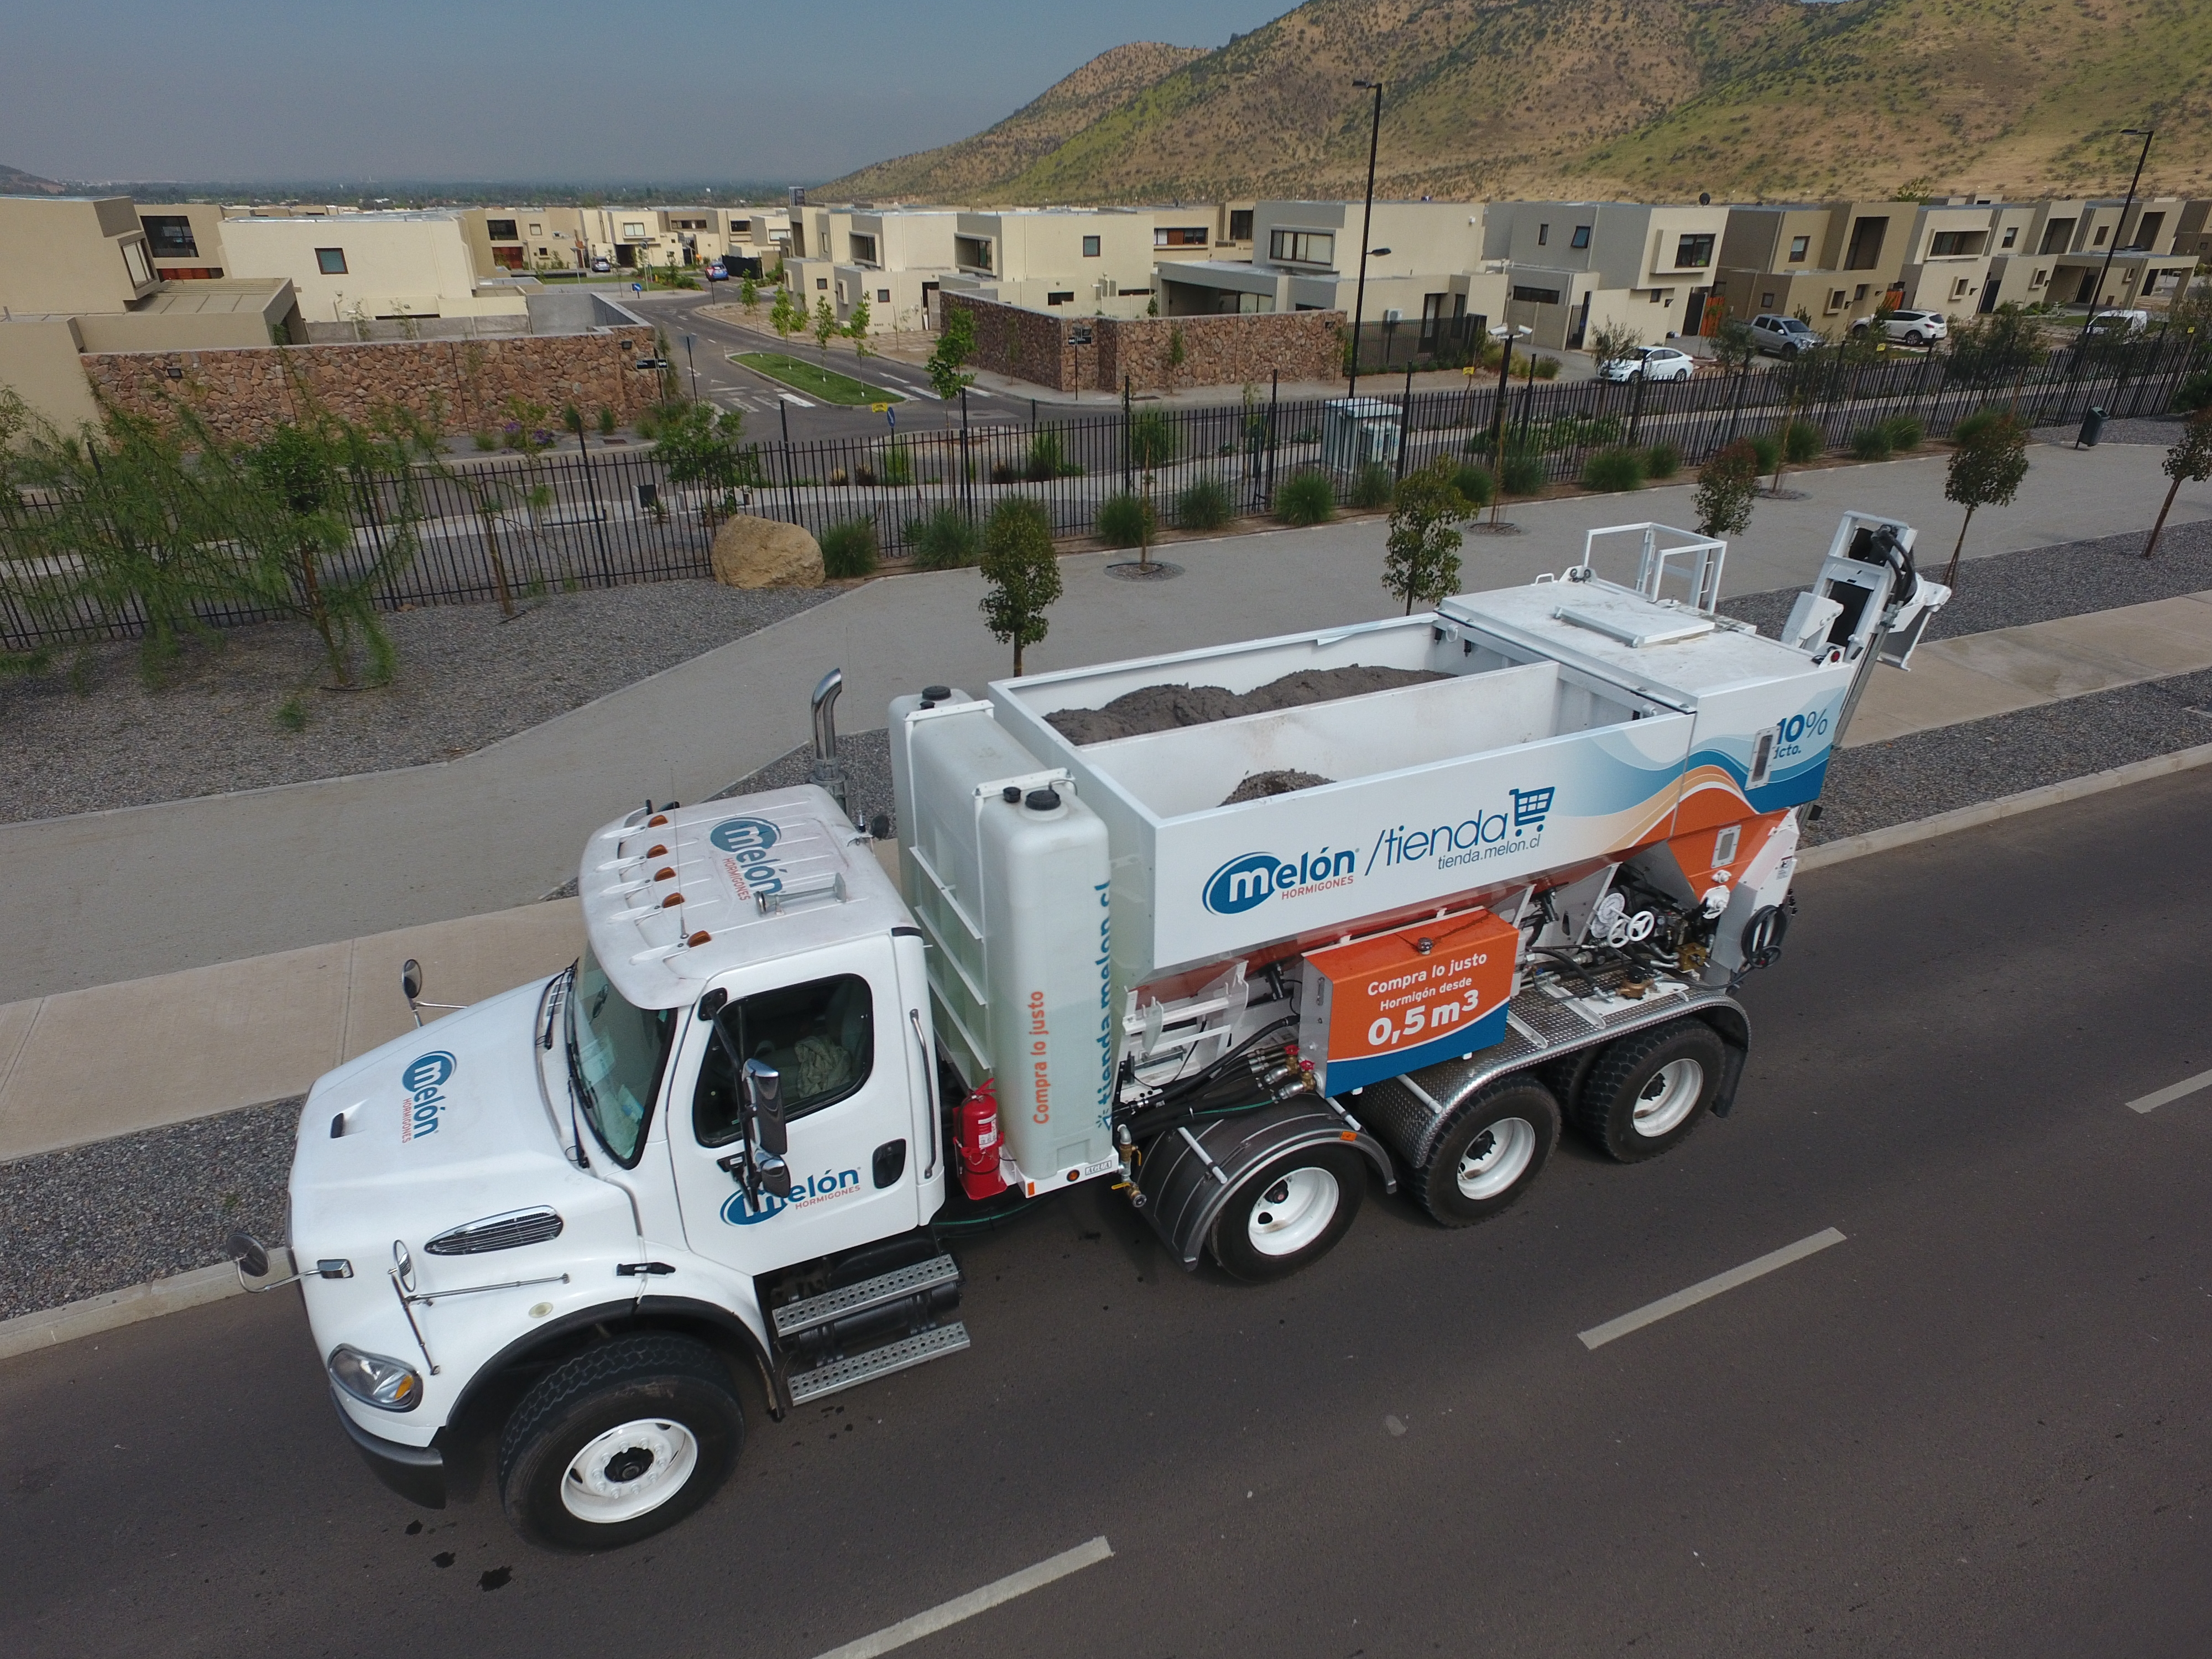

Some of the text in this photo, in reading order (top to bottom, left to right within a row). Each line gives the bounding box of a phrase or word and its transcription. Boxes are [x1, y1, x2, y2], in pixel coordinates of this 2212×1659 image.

[1777, 708, 1828, 745] 10%
[1438, 833, 1541, 870] tienda.melon.cl
[722, 857, 751, 901] HORMIGONES
[1228, 846, 1355, 903] melón
[1281, 875, 1354, 901] HORMIGONES
[1367, 953, 1488, 997] Compra lo justo
[1379, 977, 1473, 1012] Hormigón desde
[1367, 1004, 1426, 1046] 0,5
[1027, 990, 1051, 1125] Compra lo justo
[412, 1057, 449, 1140] melón
[401, 1097, 411, 1144] HORMIGONES
[1086, 1162, 1109, 1174] AGUA
[795, 1185, 861, 1210] HORMIGONES
